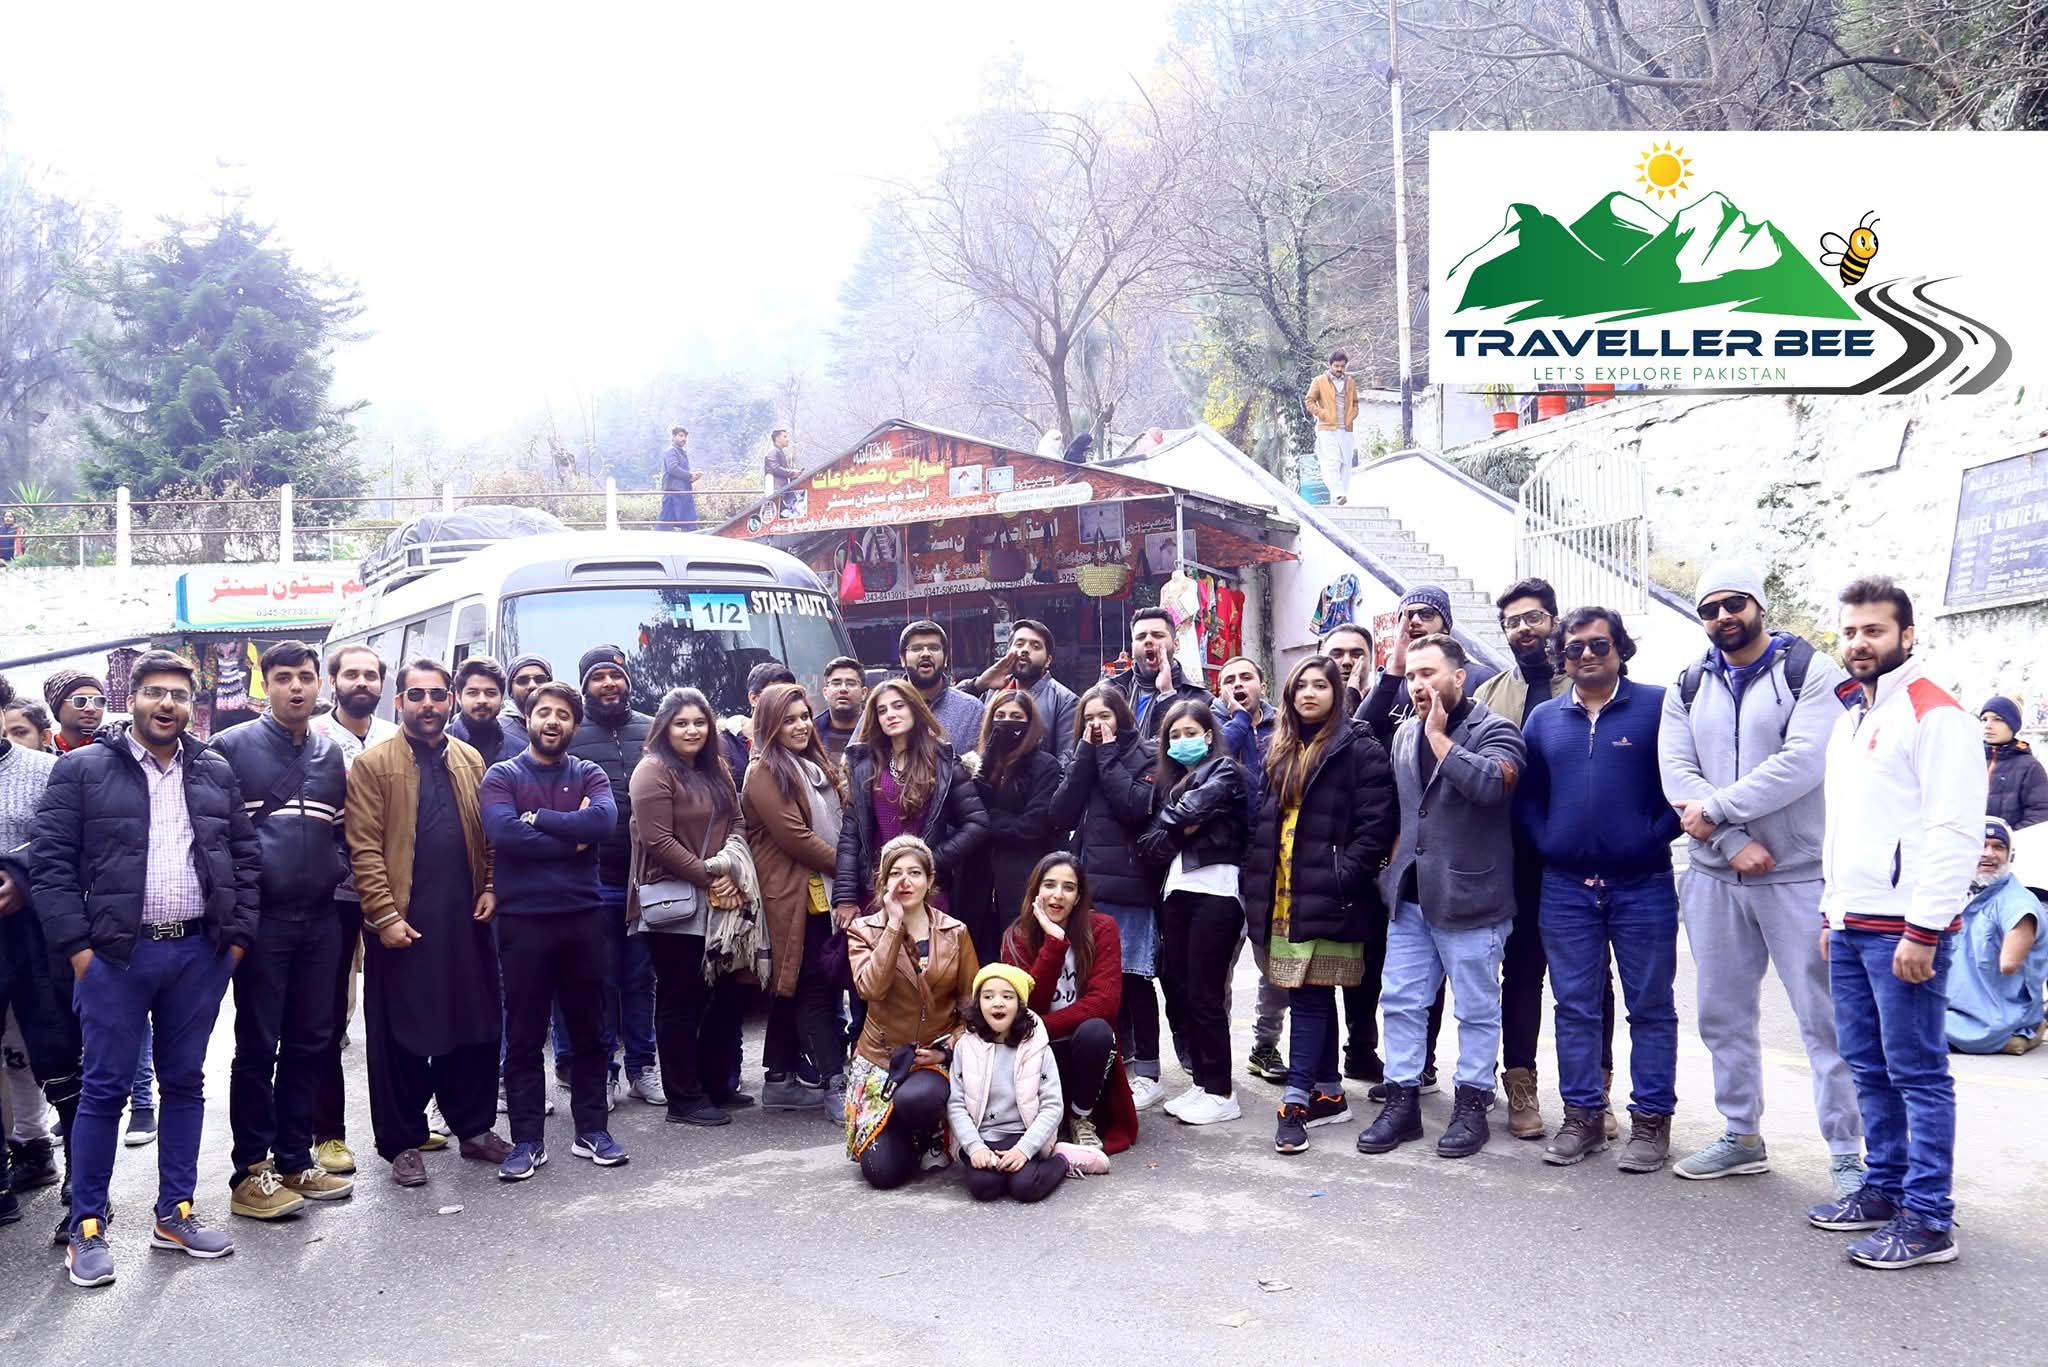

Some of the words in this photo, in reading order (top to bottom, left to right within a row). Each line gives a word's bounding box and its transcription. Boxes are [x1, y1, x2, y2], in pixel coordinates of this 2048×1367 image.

[811, 466, 888, 490] مصنوعات
[889, 456, 945, 486] سواتی
[702, 602, 743, 624] 1/2
[751, 590, 794, 615] STAFF
[794, 593, 831, 619] DUTY
[863, 590, 907, 602] 343-8413016
